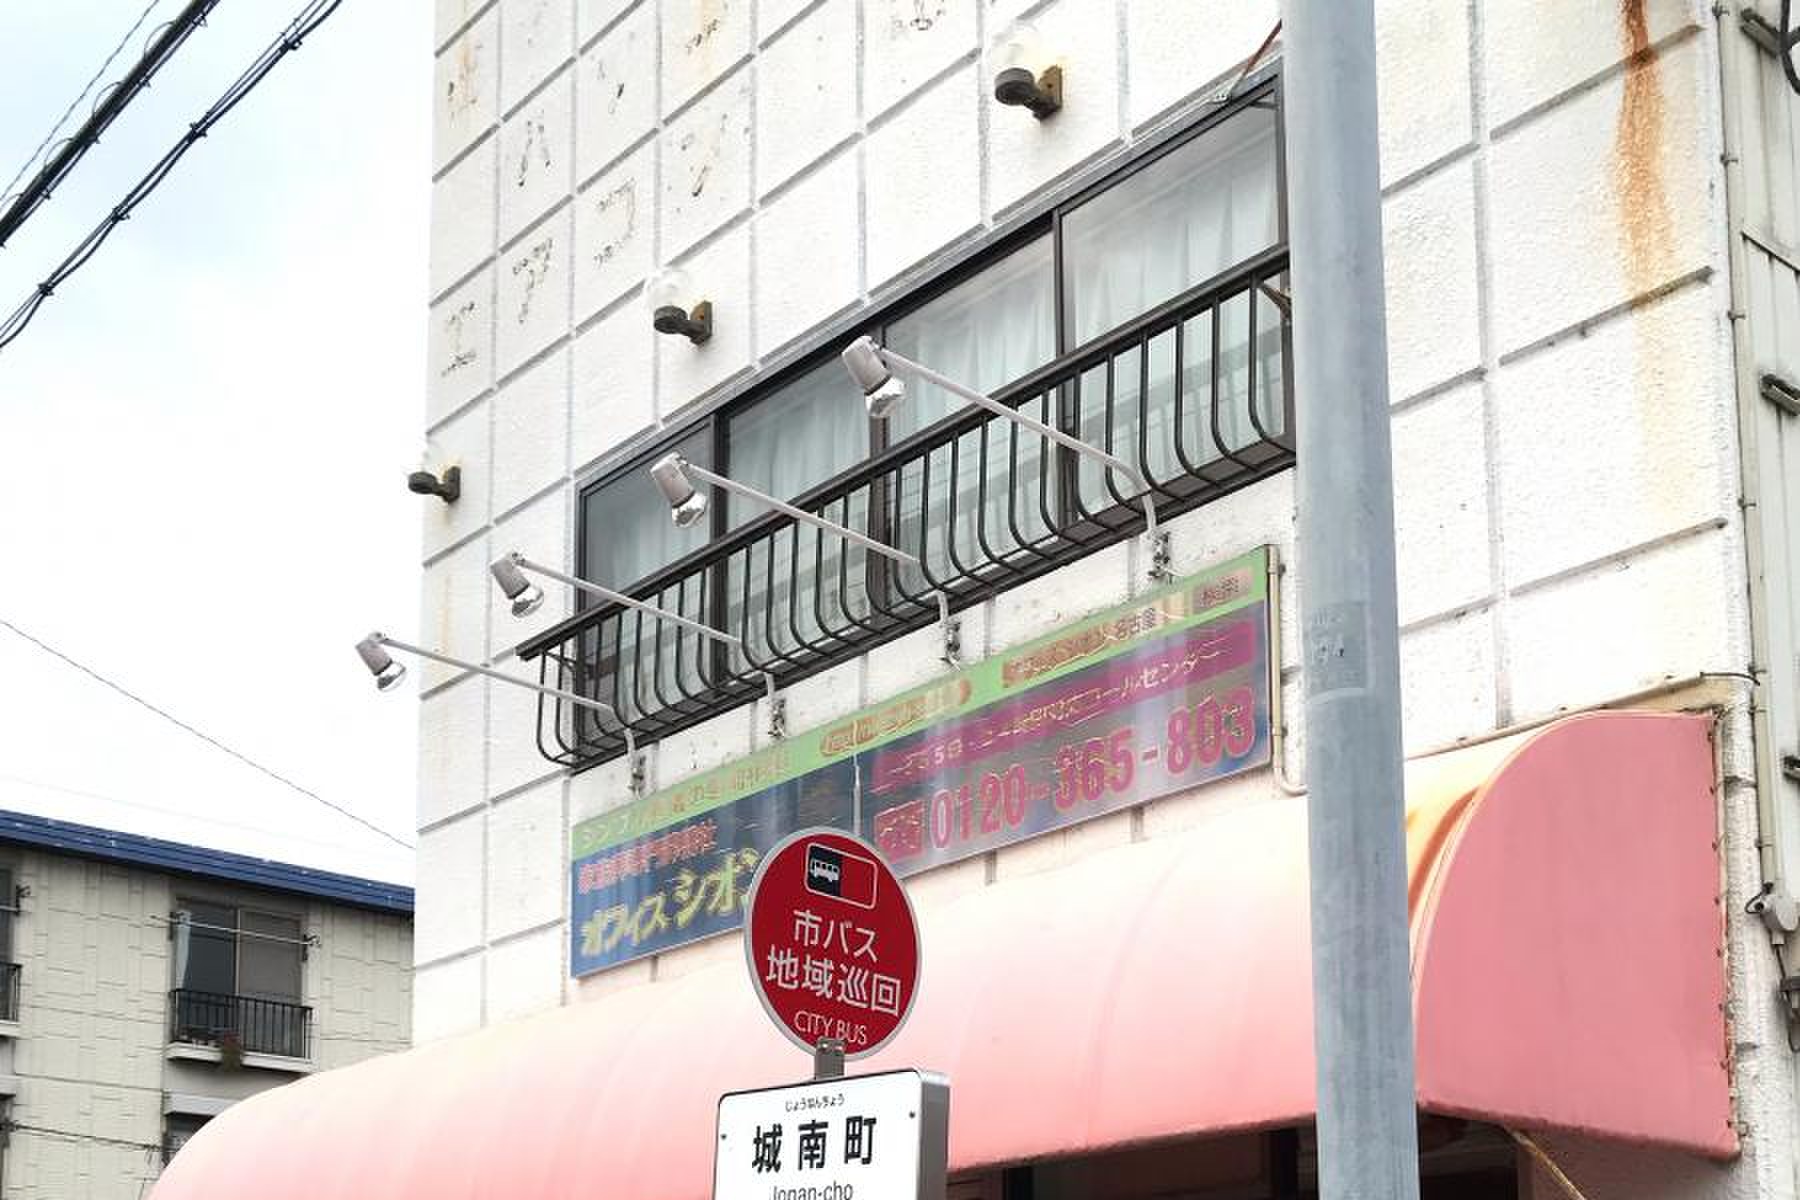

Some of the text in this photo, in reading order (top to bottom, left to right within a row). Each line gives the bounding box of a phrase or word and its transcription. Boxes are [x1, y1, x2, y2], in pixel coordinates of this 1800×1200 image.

[793, 909, 879, 963] 市バス
[766, 944, 901, 1017] 地域巡回
[794, 1010, 868, 1046] CITY BUS
[785, 1093, 845, 1113] じょうなんちょう
[752, 1115, 877, 1174] 城南町
